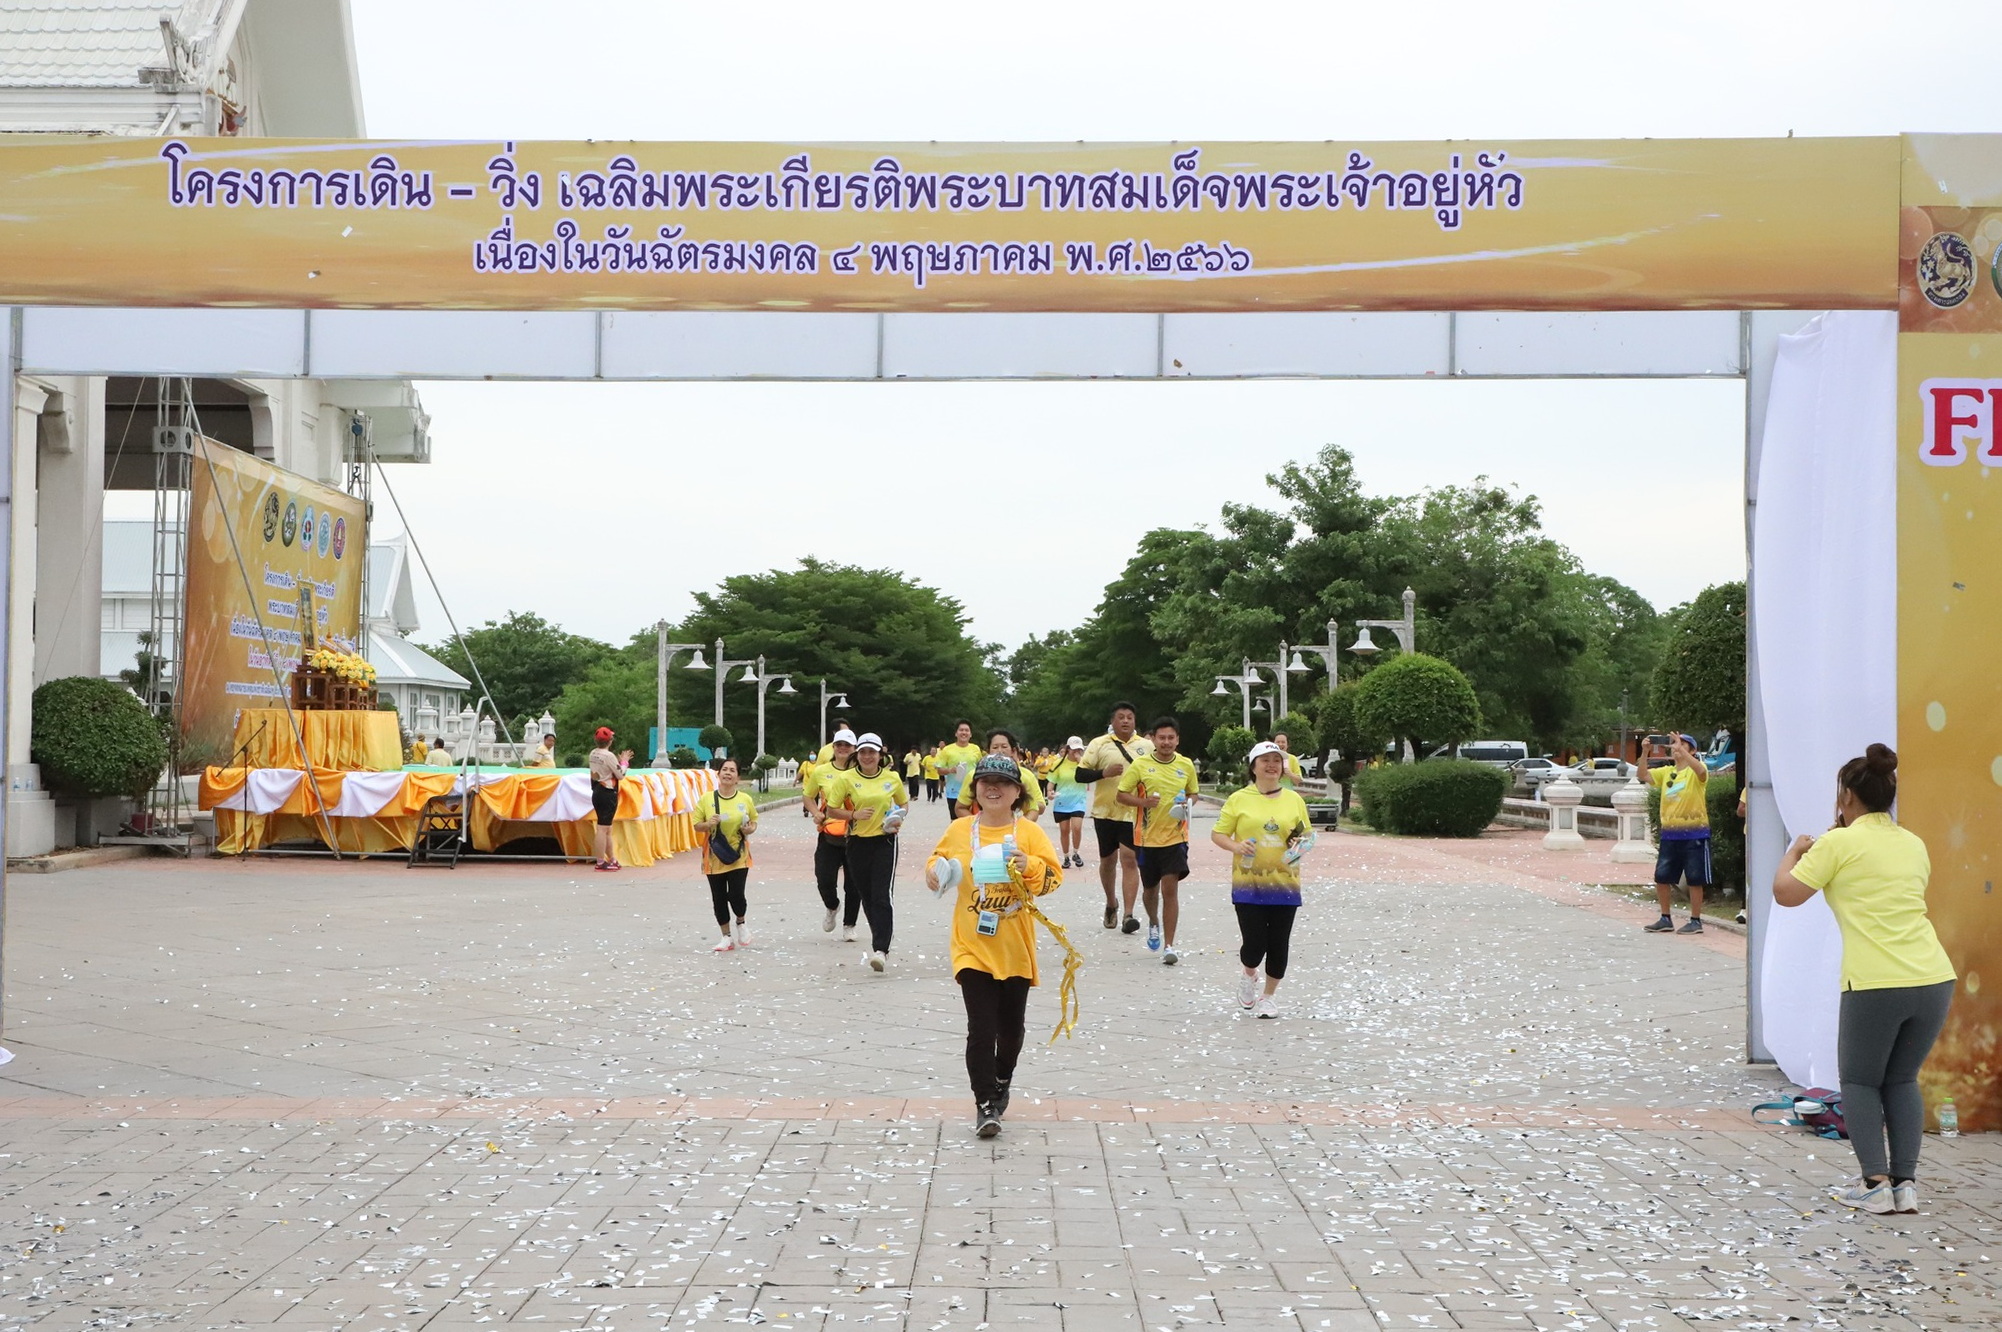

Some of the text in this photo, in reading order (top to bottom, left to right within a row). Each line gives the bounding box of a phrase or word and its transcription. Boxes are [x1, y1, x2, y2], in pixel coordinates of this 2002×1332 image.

[162, 142, 432, 206] โครงการเดิน
[488, 141, 539, 208] วิ่ง
[561, 149, 1523, 228] เฉลิมพระเกียรติพระบาทสมเด็จพระเจ้าอยู่หัว
[475, 217, 1251, 285] เนื่องในวันฉัตรมงคล ๔ พฤษภาคม พ.ศ.๒๕๖๖
